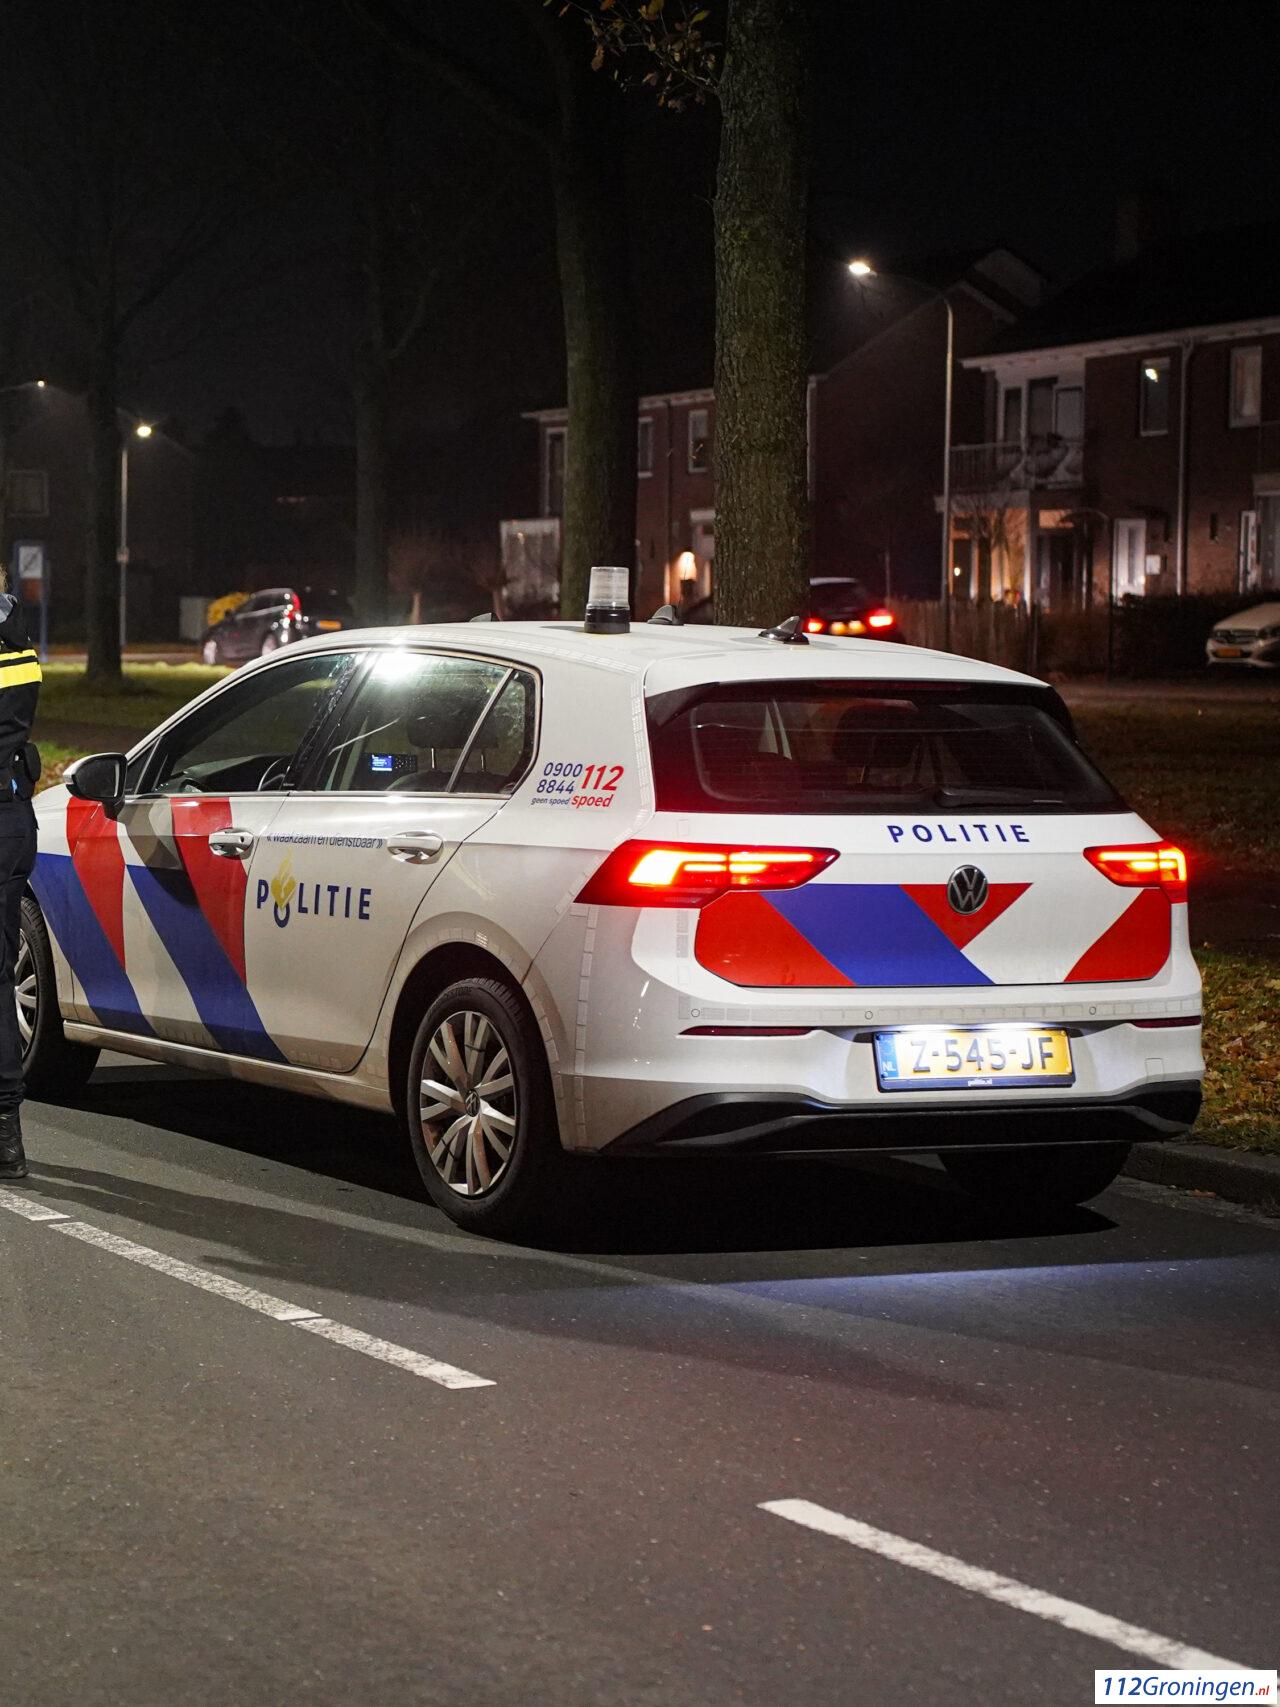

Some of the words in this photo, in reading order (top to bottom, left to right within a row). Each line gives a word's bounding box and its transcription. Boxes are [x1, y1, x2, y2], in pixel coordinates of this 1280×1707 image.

[543, 762, 583, 778] 0900
[581, 764, 624, 791] 112
[536, 779, 575, 794] 8844
[531, 797, 548, 806] geen
[549, 798, 571, 806] spoed
[571, 794, 614, 809] spoed
[887, 824, 1030, 843] POLITIE
[256, 878, 373, 929] POLITIE
[910, 1037, 1053, 1072] Z-545-JF
[882, 1062, 897, 1072] NL
